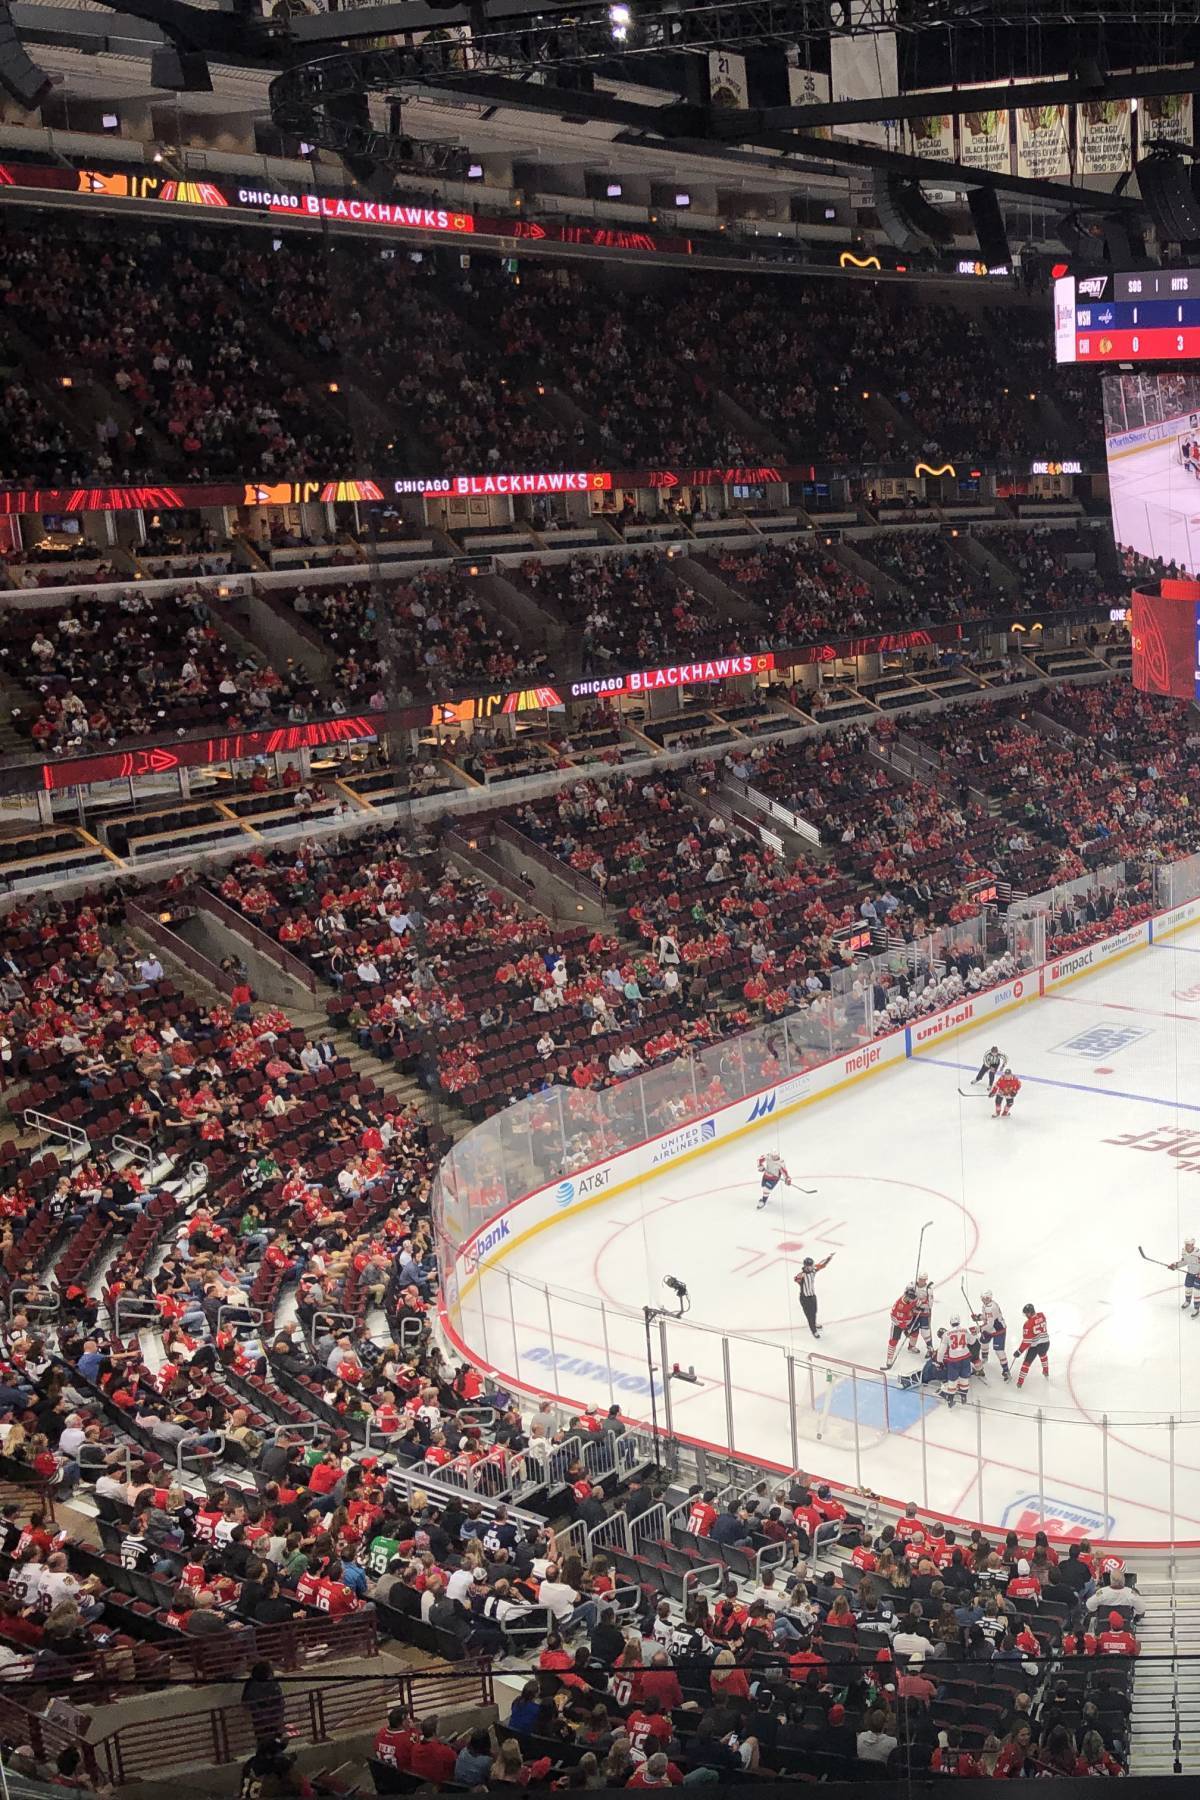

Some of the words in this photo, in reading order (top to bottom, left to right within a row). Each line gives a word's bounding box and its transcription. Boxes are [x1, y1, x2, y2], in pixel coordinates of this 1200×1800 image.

[239, 190, 298, 209] CHICAGO
[307, 195, 448, 228] BLACKHAWKS
[959, 262, 974, 274] ONE
[1128, 280, 1142, 293] SOG
[1172, 278, 1188, 290] HITS
[1078, 310, 1091, 326] WSH
[1177, 336, 1183, 351] 3
[1033, 463, 1049, 474] ONE
[1063, 462, 1082, 474] GOAL
[395, 480, 450, 493] CHICAGO
[457, 473, 588, 494] BLACKHAWKS
[1110, 609, 1126, 621] ONE
[572, 678, 623, 697] CHICAGO
[630, 656, 752, 690] BLACKHAWKS
[1101, 929, 1143, 953] WeatherTech
[1060, 950, 1093, 976] impact
[917, 1004, 973, 1041] uni-ball
[846, 1047, 881, 1074] meijer
[652, 1138, 699, 1163] AIRLINES
[661, 1128, 698, 1150] UNITED
[578, 1168, 612, 1195] AT&T
[950, 1335, 966, 1349] 34
[1026, 1501, 1105, 1529] MARATHON
